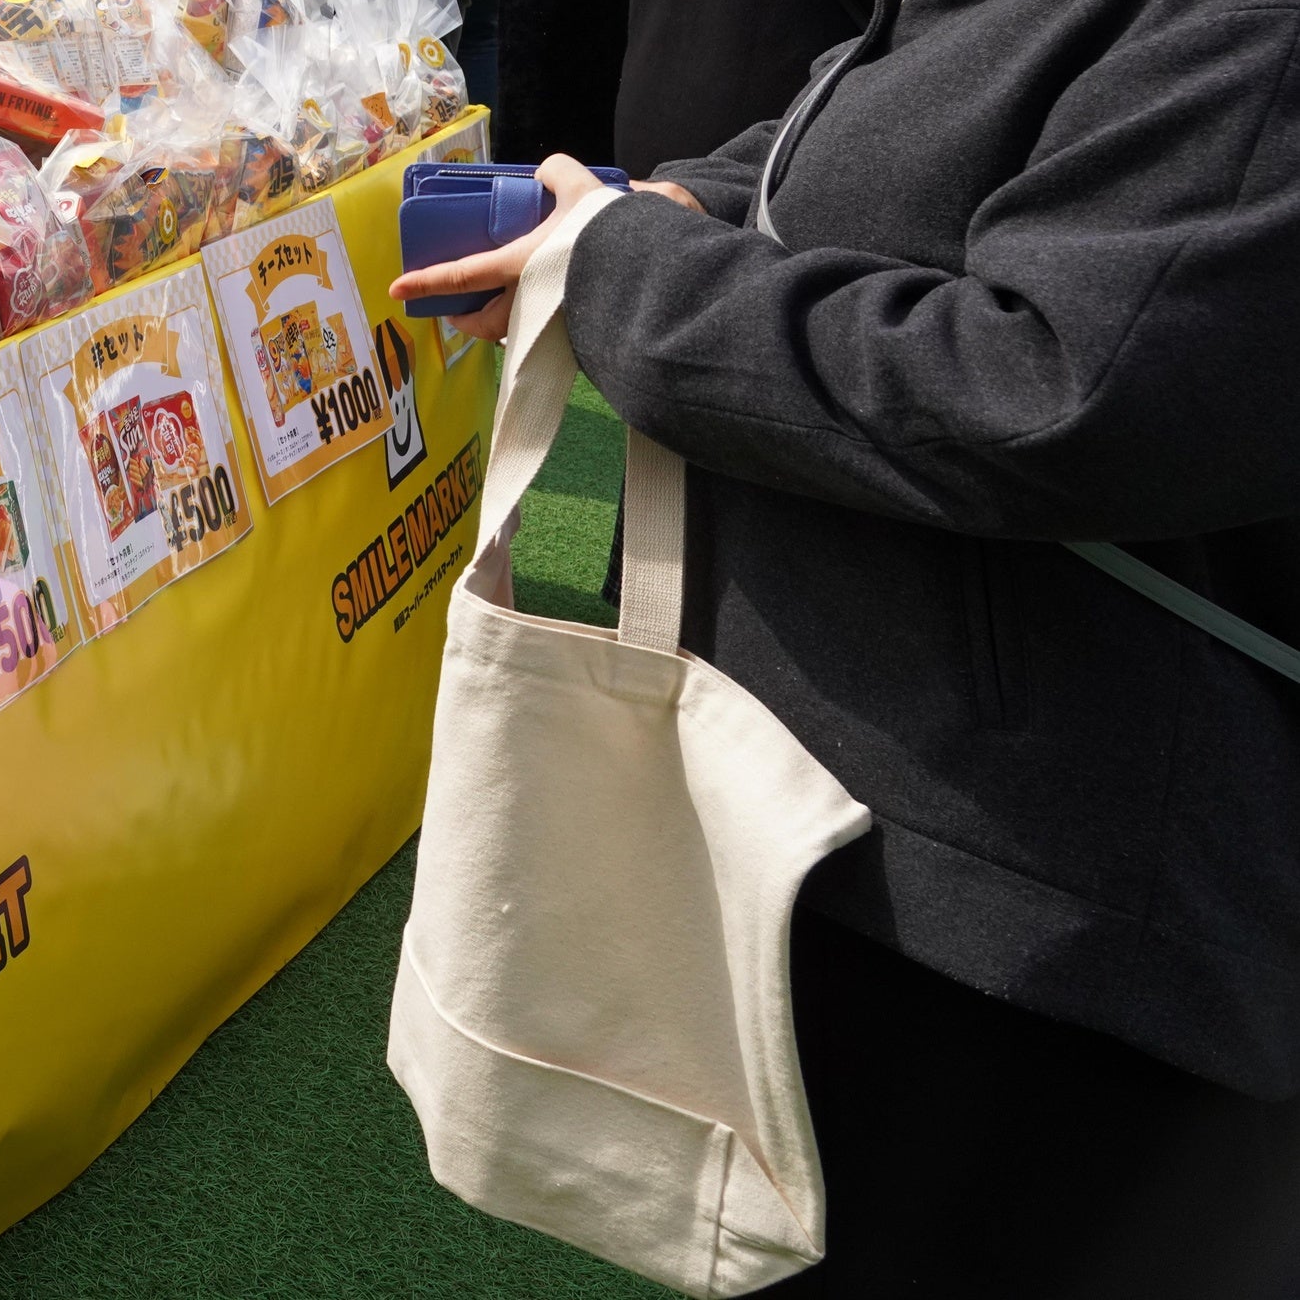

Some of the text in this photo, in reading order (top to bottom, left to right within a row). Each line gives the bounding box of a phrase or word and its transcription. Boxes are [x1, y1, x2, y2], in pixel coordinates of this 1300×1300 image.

[8, 93, 52, 118] FRYING
[258, 241, 313, 287] チーズセット
[310, 368, 382, 445] ¥1000
[331, 431, 484, 643] SMILE MARKET
